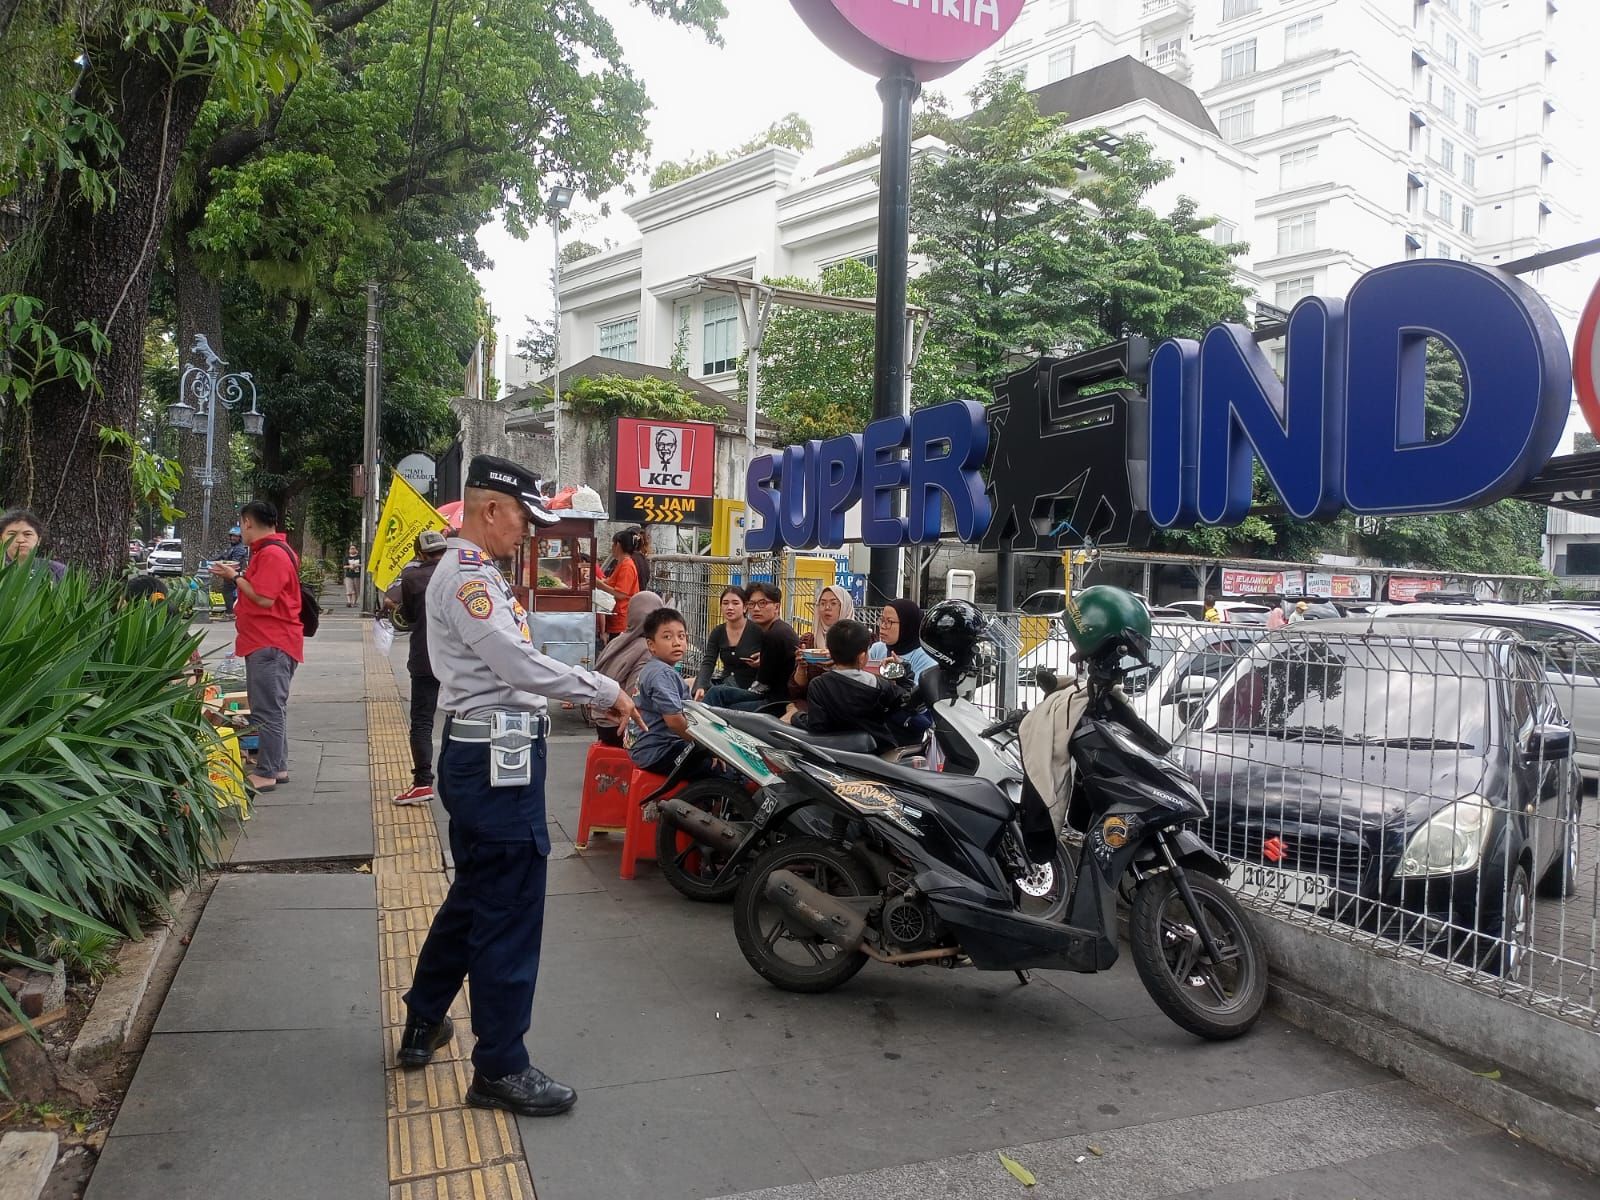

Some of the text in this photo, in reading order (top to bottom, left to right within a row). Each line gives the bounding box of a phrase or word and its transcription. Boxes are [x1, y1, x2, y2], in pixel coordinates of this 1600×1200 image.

[745, 258, 1600, 552] SUPER IND
[648, 473, 682, 487] KFC
[633, 496, 696, 512] 24 JAM
[1152, 790, 1184, 807] HONDA
